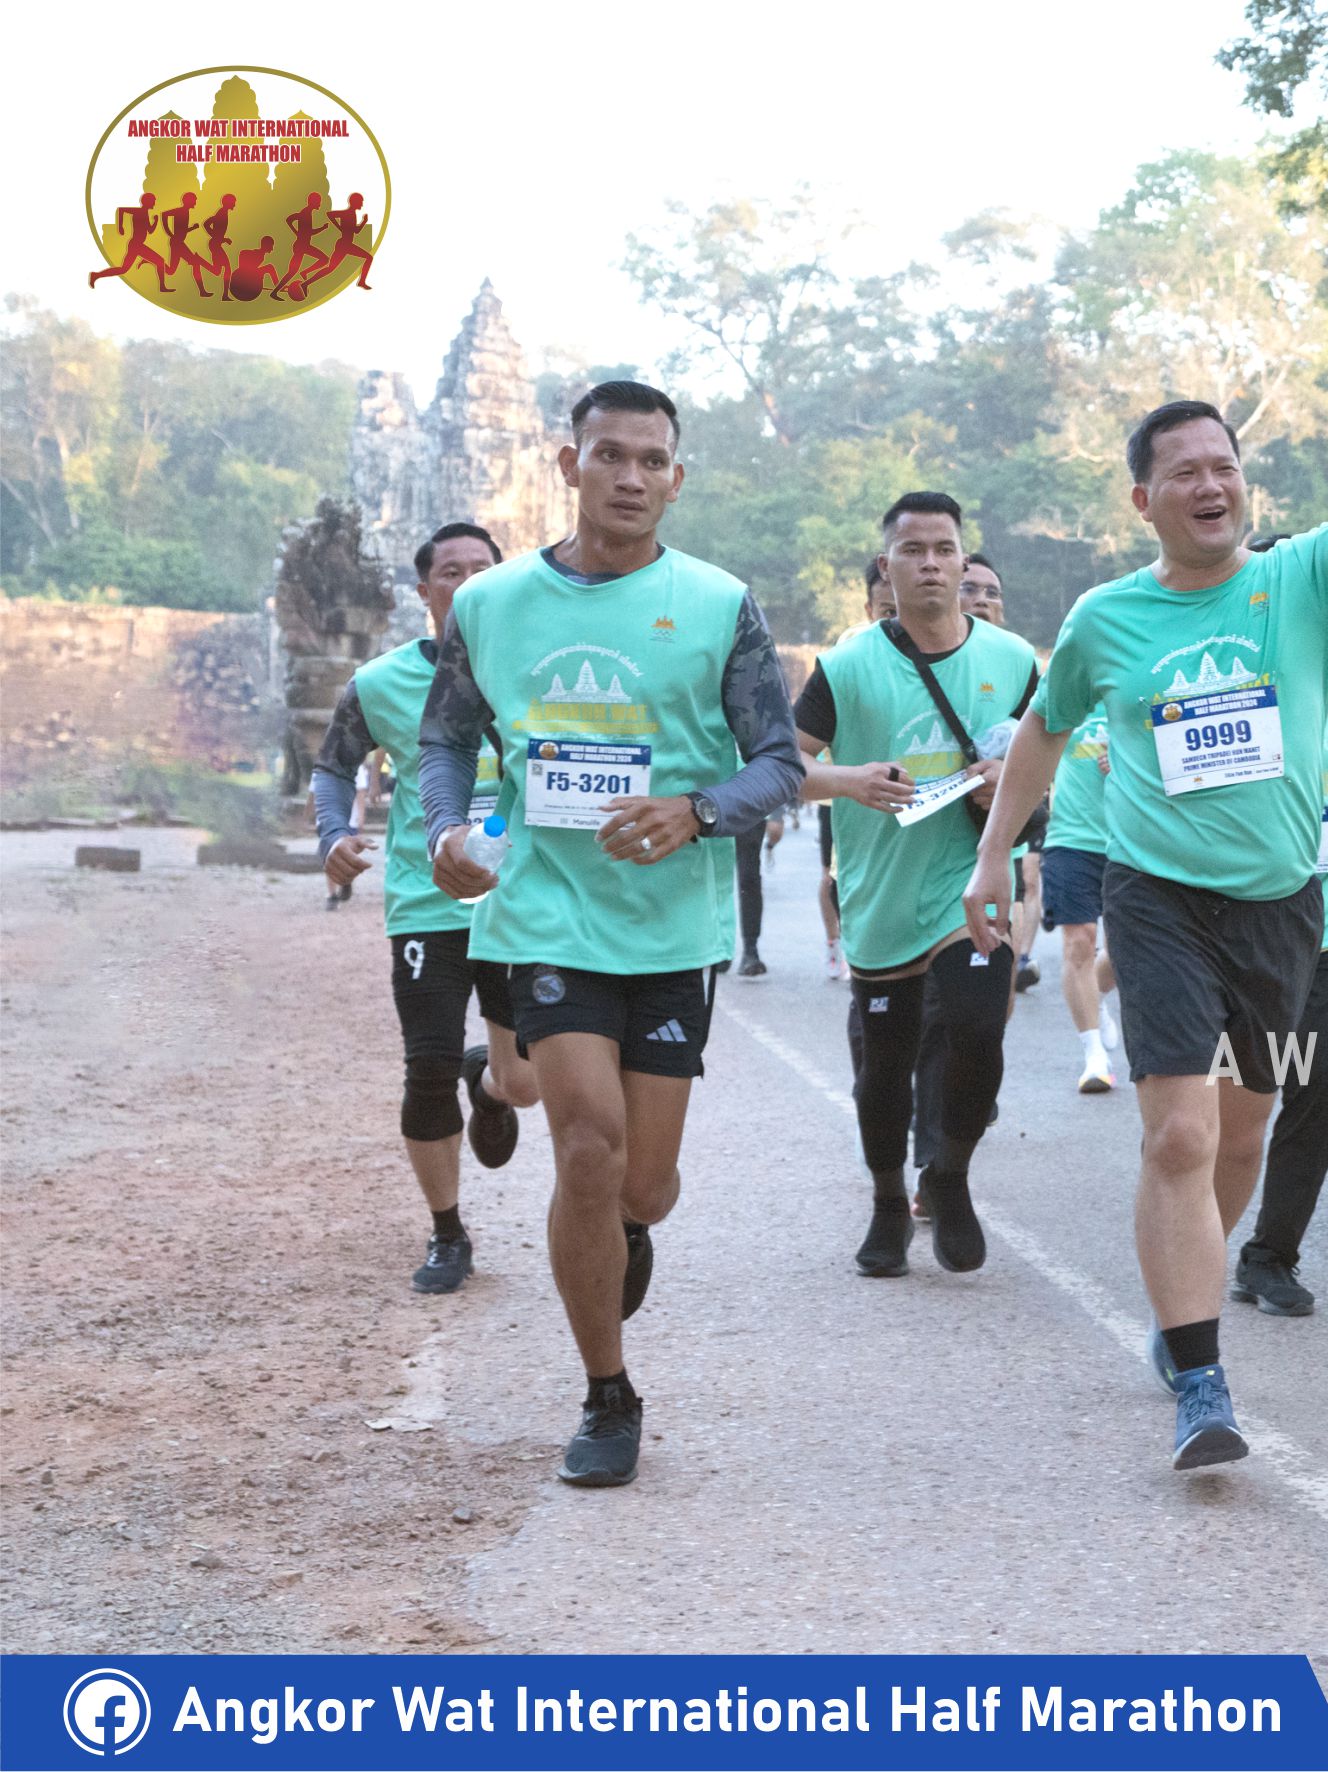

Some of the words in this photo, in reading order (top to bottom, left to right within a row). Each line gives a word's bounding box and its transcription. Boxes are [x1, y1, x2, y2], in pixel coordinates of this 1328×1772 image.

[1185, 720, 1252, 751] 9999
[546, 771, 631, 794] F5-3201
[403, 939, 425, 980] 9
